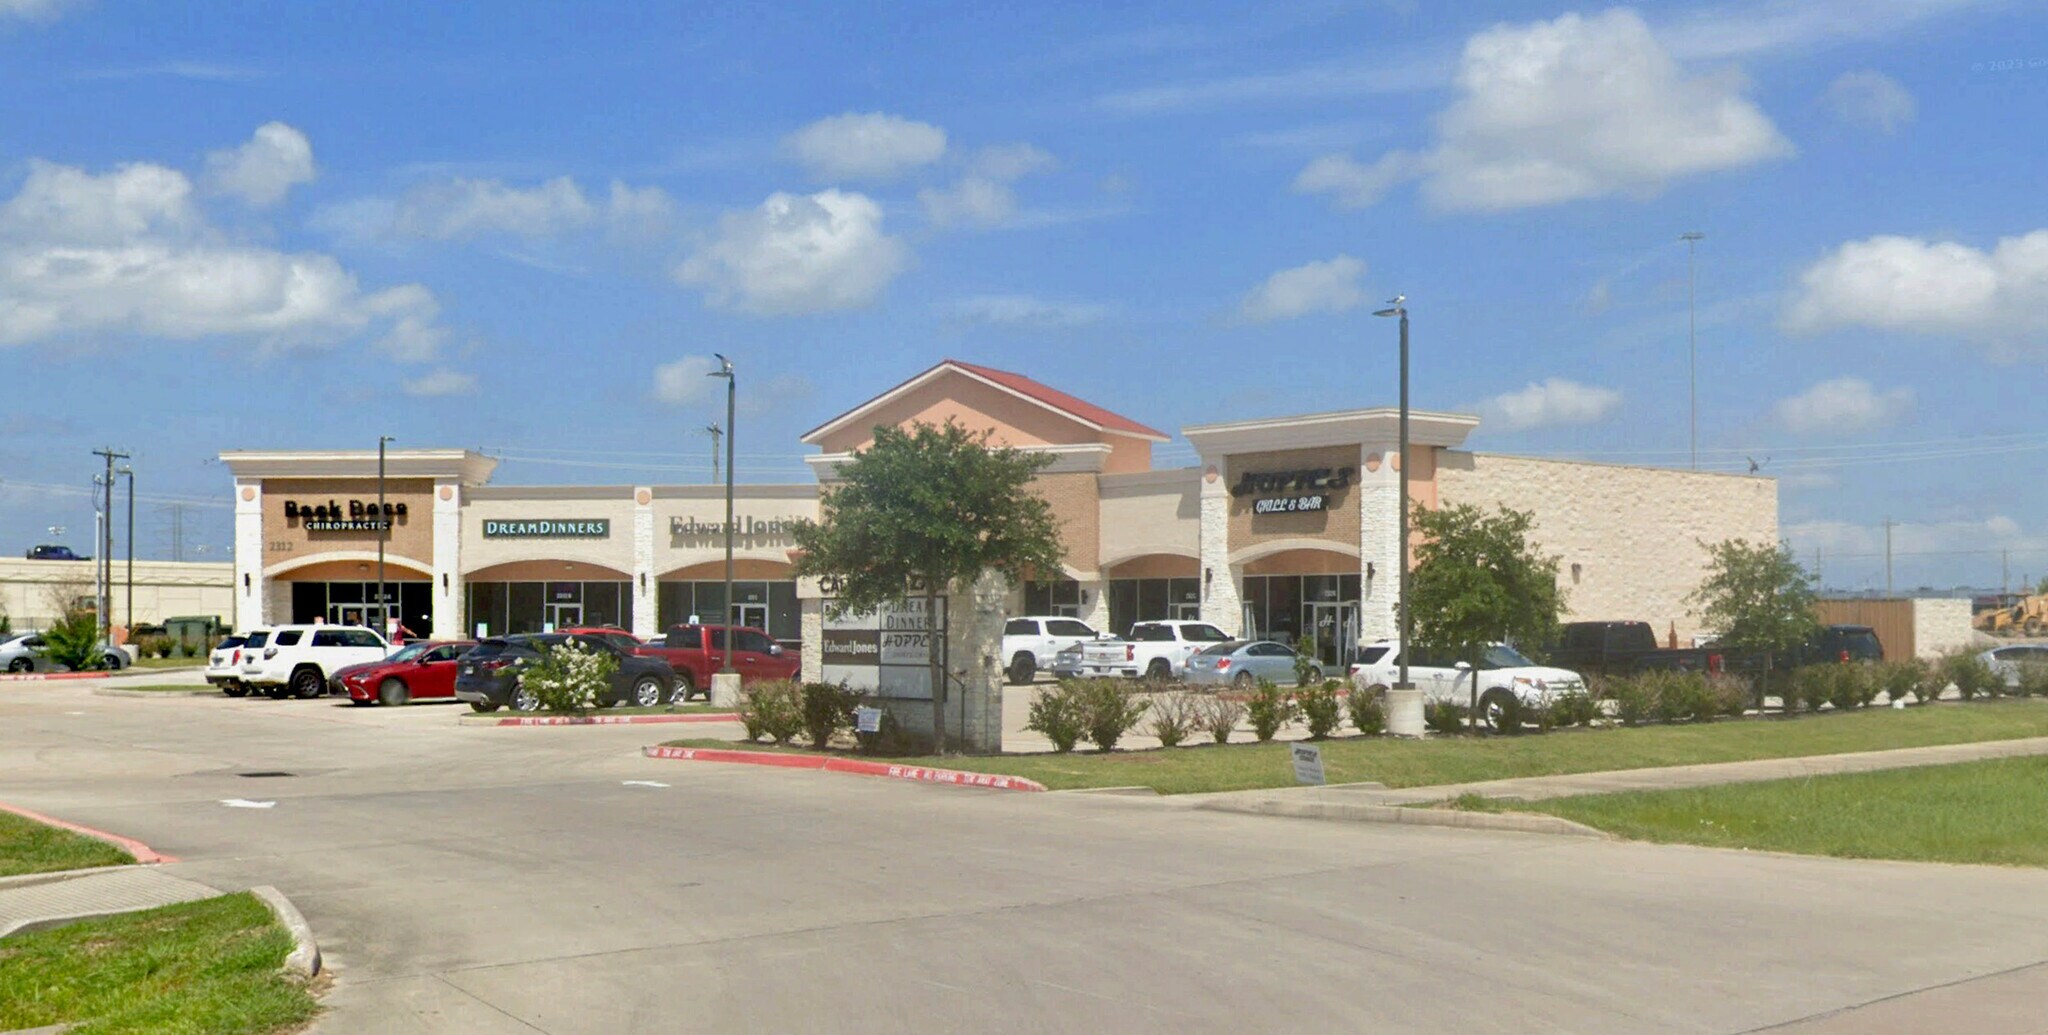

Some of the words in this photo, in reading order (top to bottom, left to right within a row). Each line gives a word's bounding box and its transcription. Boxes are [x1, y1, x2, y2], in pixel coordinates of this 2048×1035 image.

[1256, 500, 1287, 514] GRILL
[1298, 496, 1322, 510] BAR
[746, 515, 803, 536] Jone
[852, 640, 877, 654] Jones
